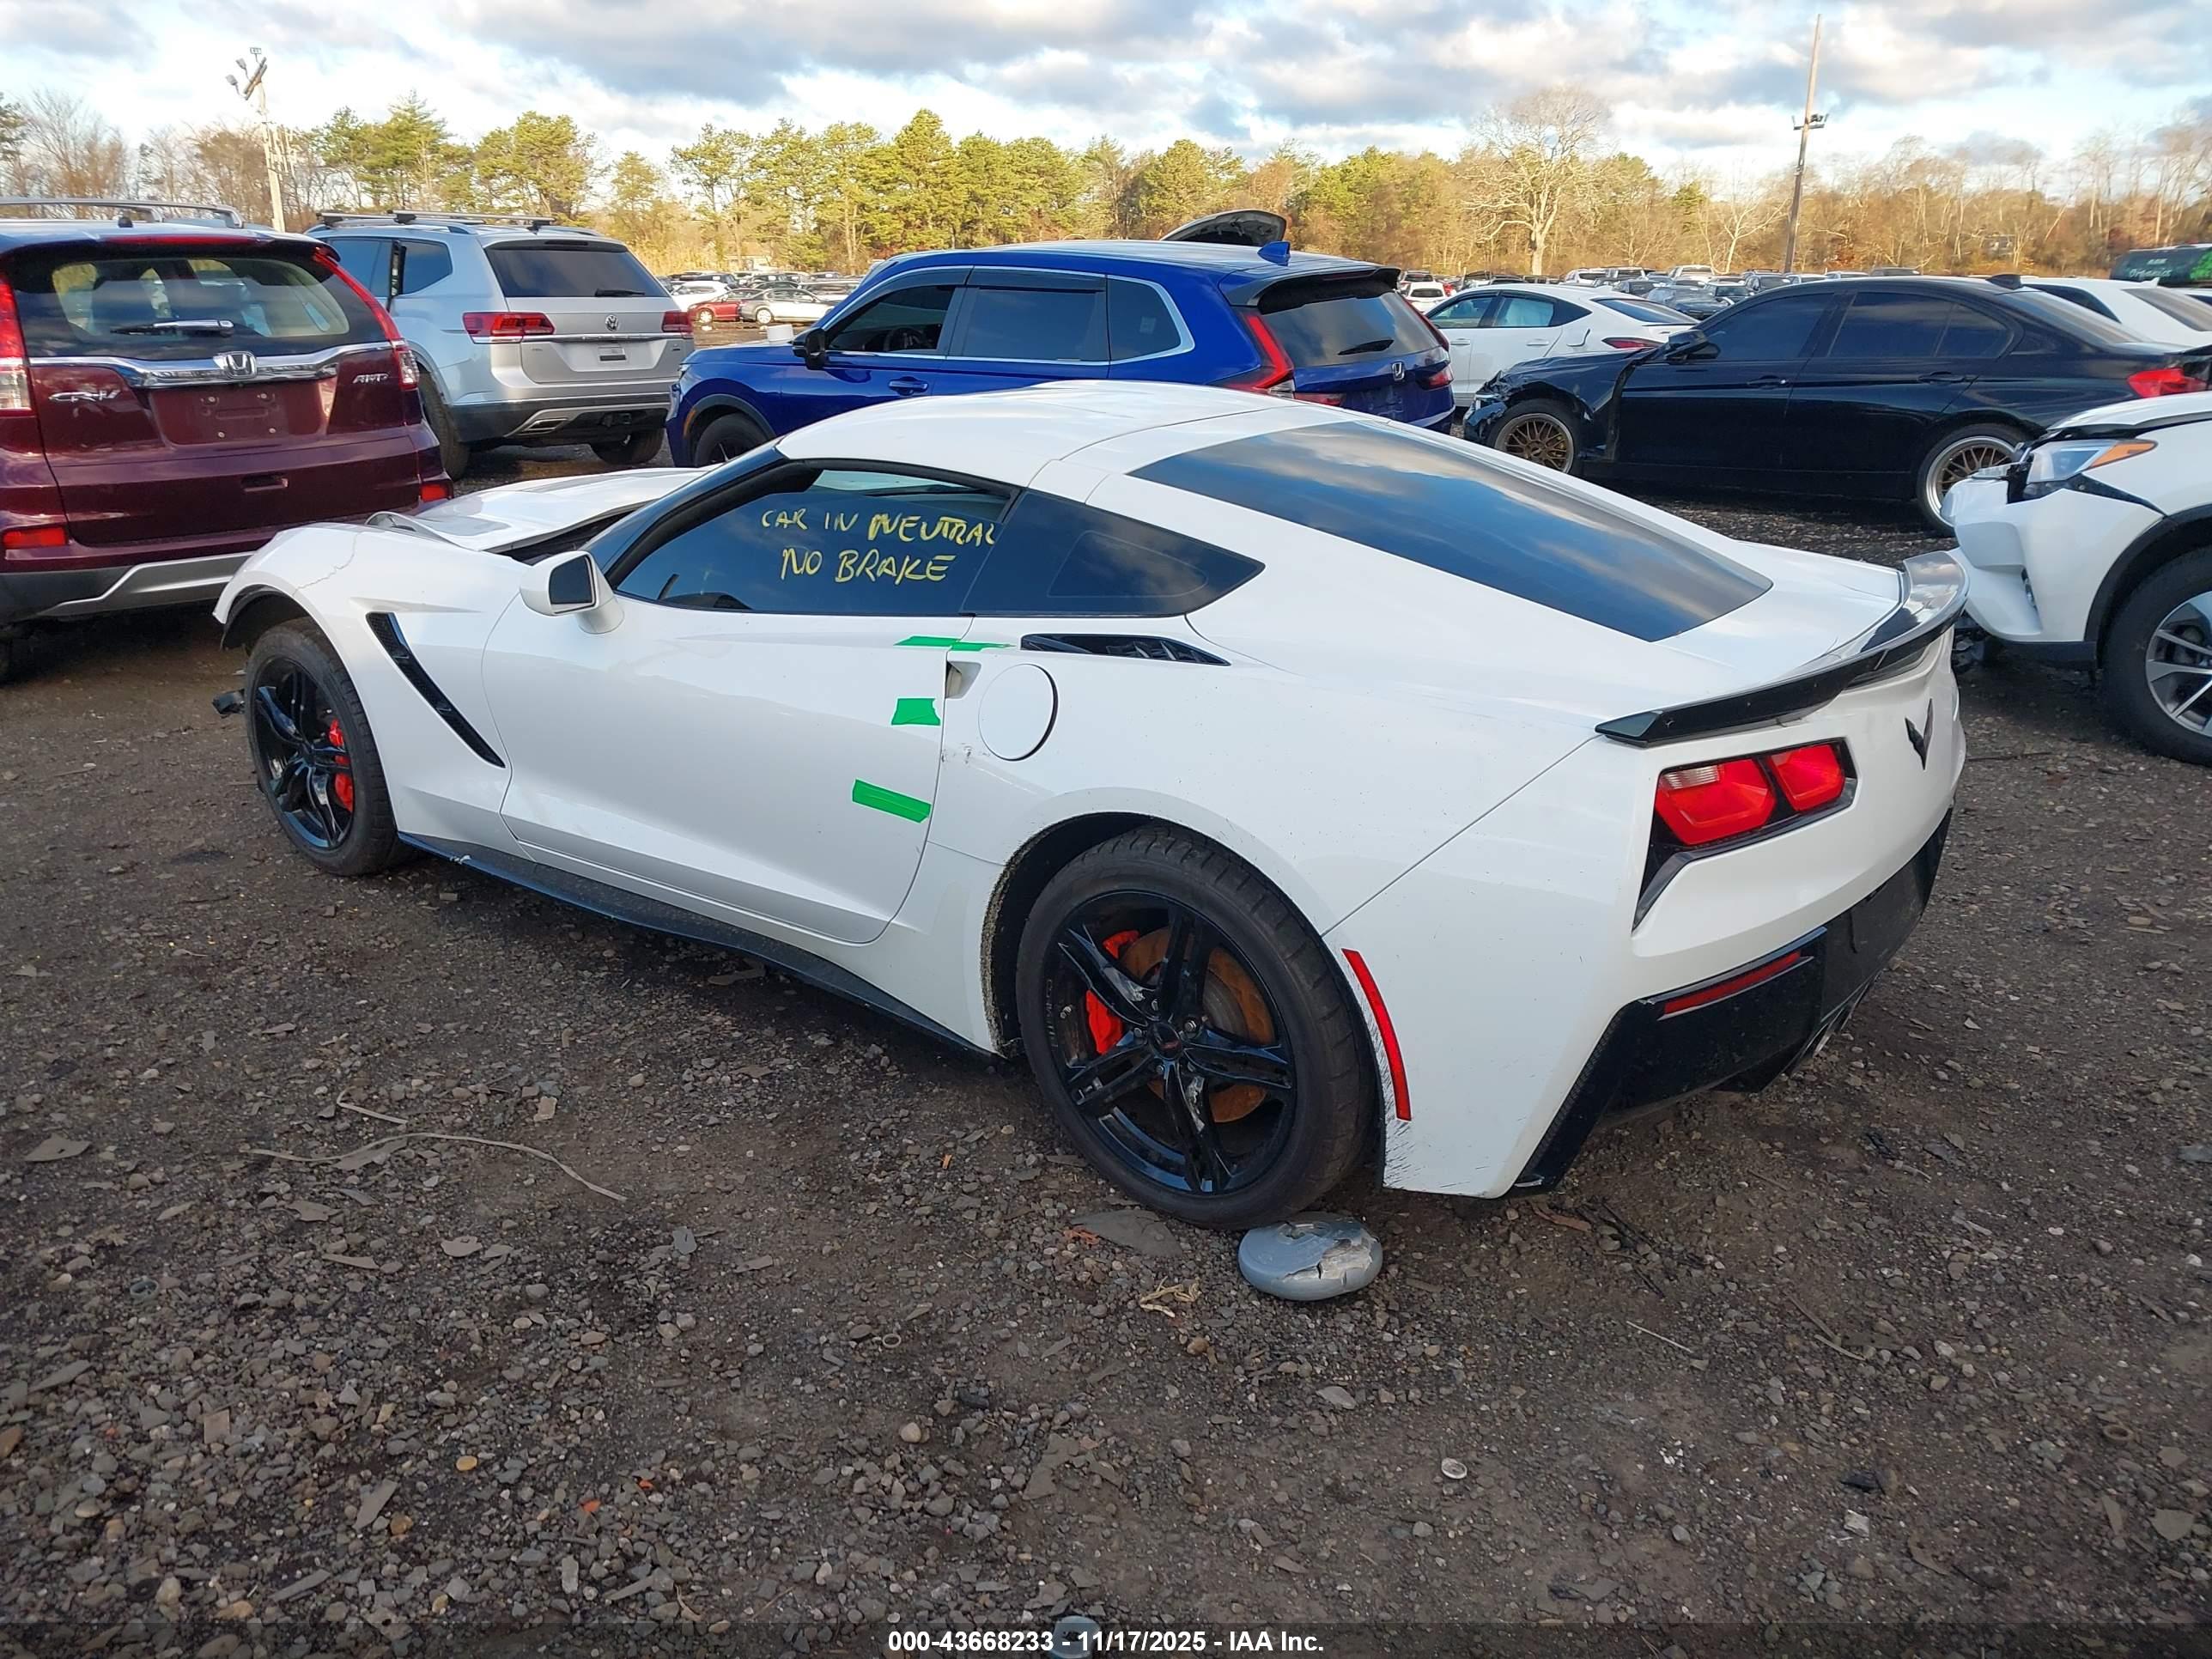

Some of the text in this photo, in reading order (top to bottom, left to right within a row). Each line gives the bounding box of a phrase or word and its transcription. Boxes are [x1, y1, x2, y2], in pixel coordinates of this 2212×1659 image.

[762, 508, 996, 547] CAR IN NEUTRAL
[781, 548, 957, 586] NO BRAKE
